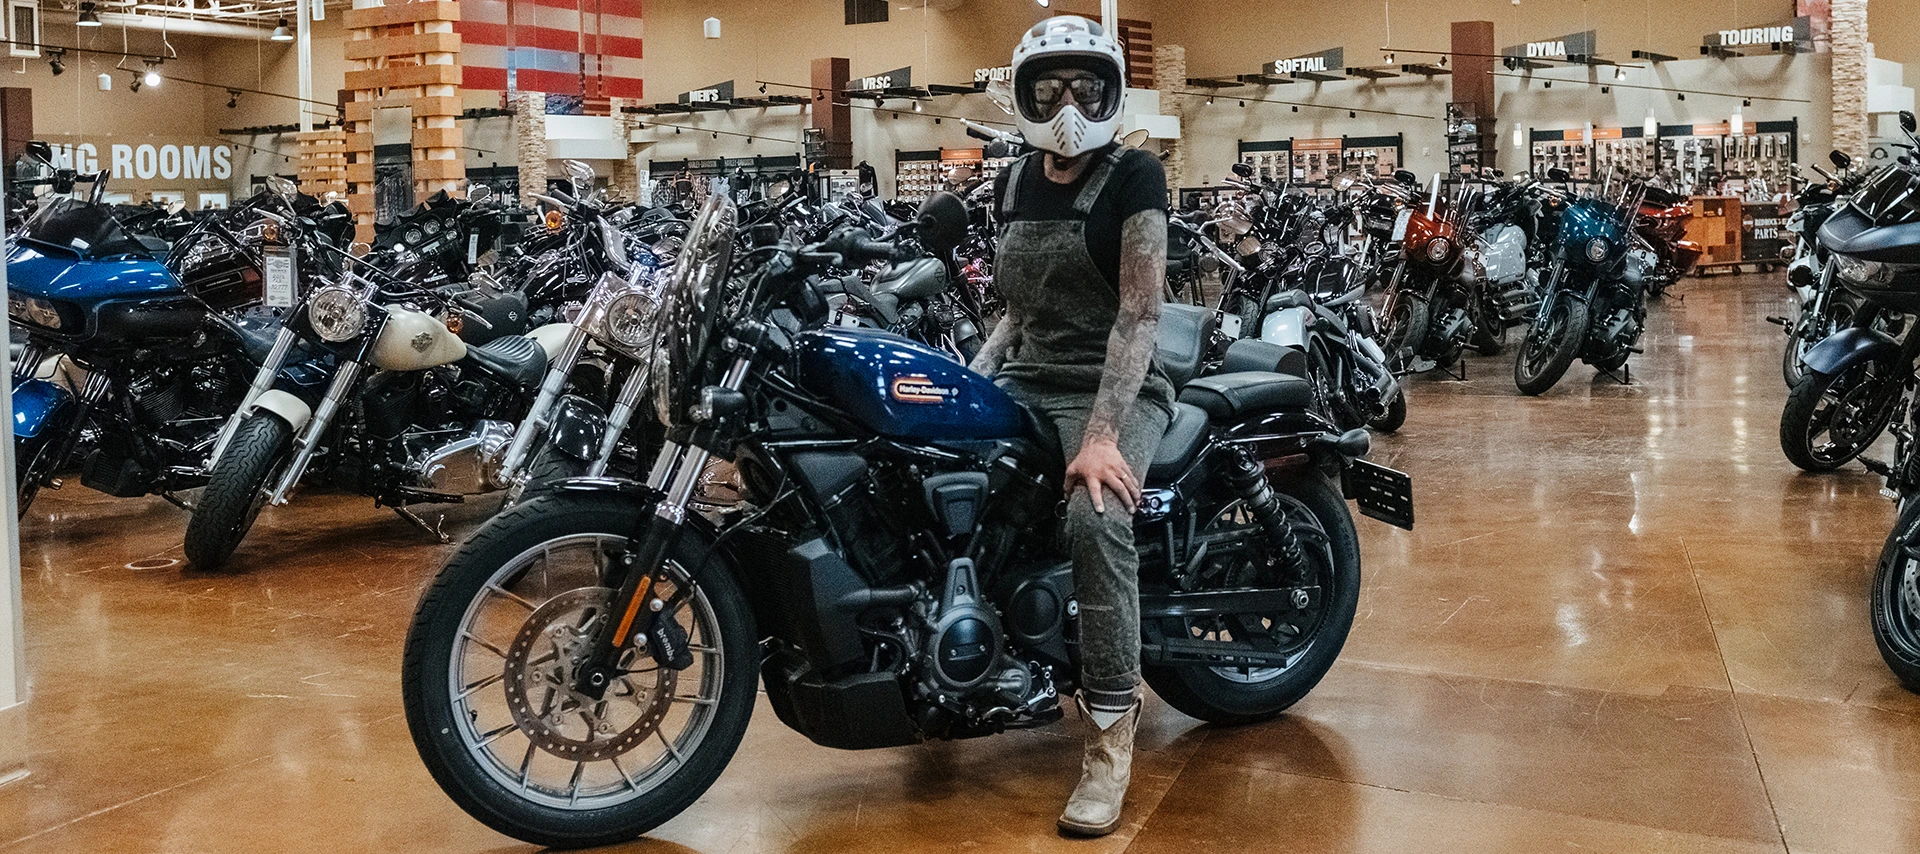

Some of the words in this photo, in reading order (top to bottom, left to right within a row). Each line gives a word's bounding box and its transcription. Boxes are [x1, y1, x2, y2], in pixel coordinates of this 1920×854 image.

[1719, 26, 1793, 46] TOURING
[1526, 41, 1566, 57] DYNA
[1274, 57, 1327, 74] SOFTAIL
[862, 76, 892, 90] VRSC
[111, 143, 232, 180] ROOMS
[1754, 228, 1778, 239] PARTS
[899, 384, 949, 395] Harley-Davidson
[656, 627, 675, 661] brembo
